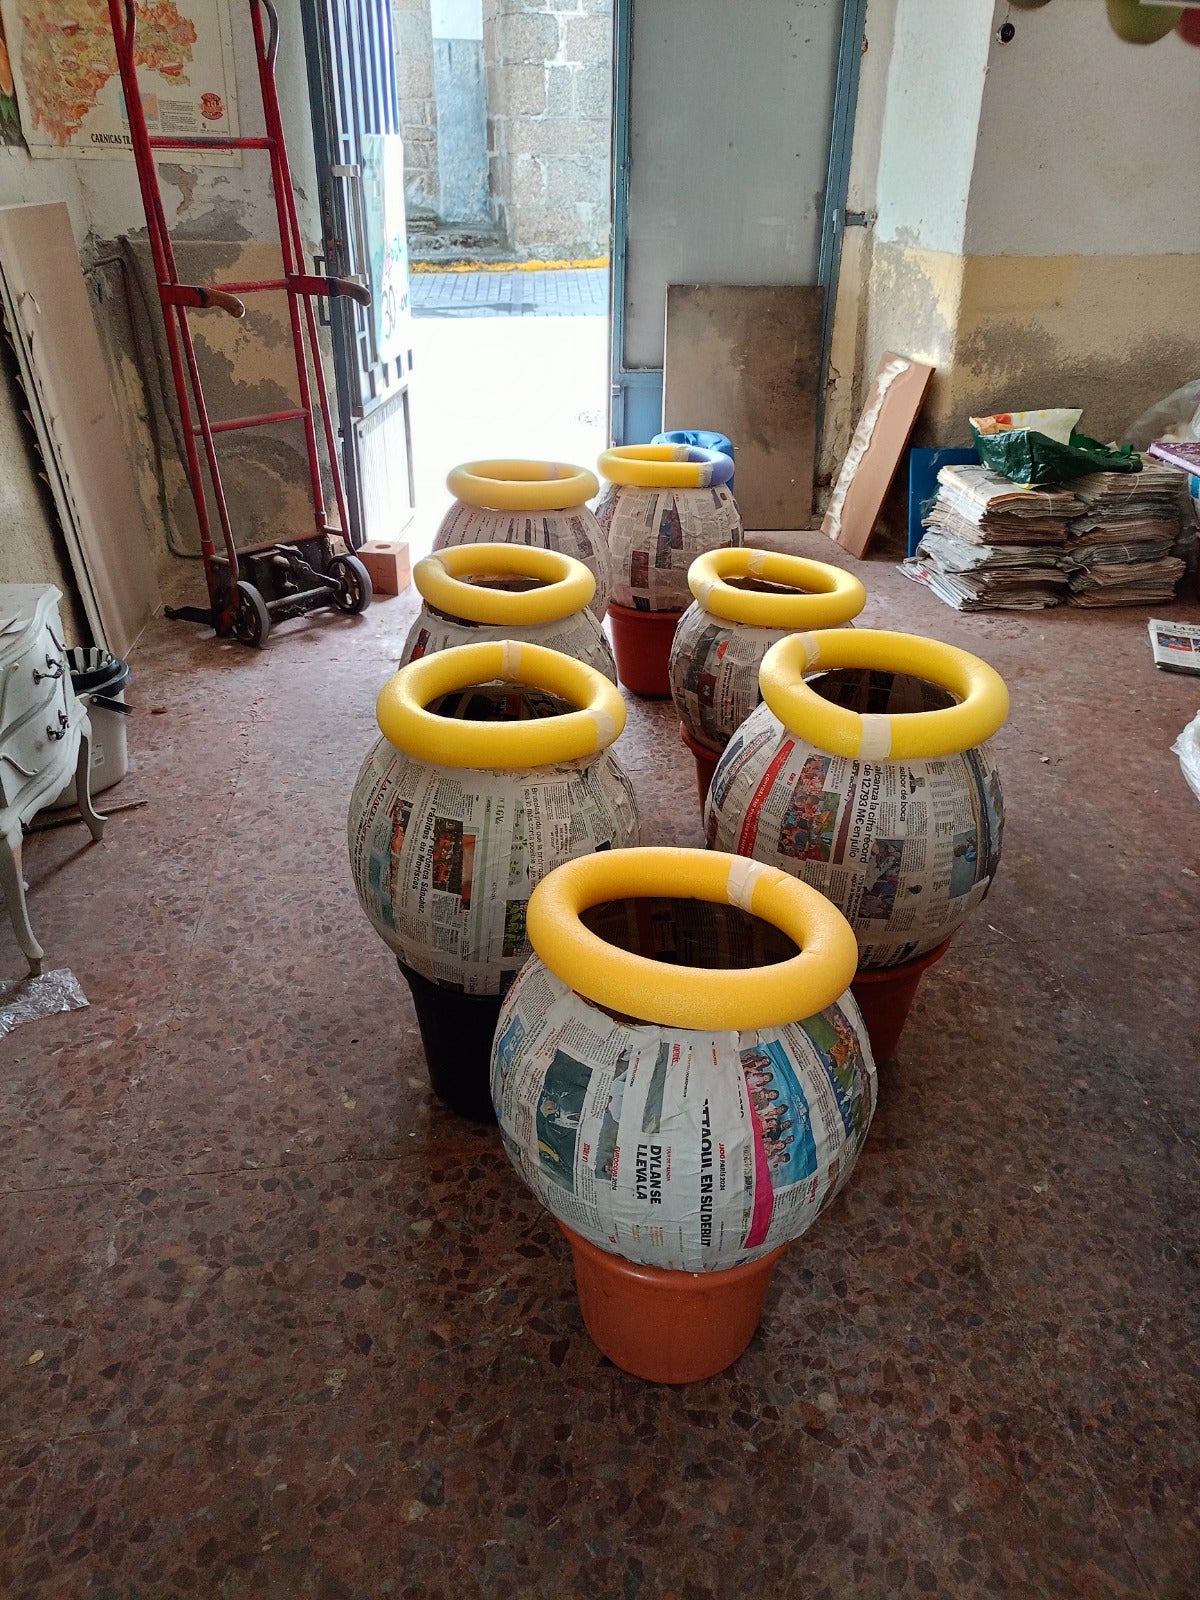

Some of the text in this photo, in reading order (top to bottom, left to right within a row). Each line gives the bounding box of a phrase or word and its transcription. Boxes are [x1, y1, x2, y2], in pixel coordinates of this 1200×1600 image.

[90, 133, 133, 145] CARNICAS TR
[899, 766, 908, 822] sabor de boca
[423, 808, 437, 840] rápidos
[848, 764, 874, 858] de 12.793 M€ en julio
[859, 765, 883, 864] alcanza la cifra récord
[418, 841, 427, 852] en
[636, 1143, 648, 1200] LLEVA LA
[650, 1144, 662, 1205] DYLAN SE
[700, 1174, 713, 1194] EN
[700, 1195, 713, 1214] SU
[700, 1215, 713, 1248] DEBUT
